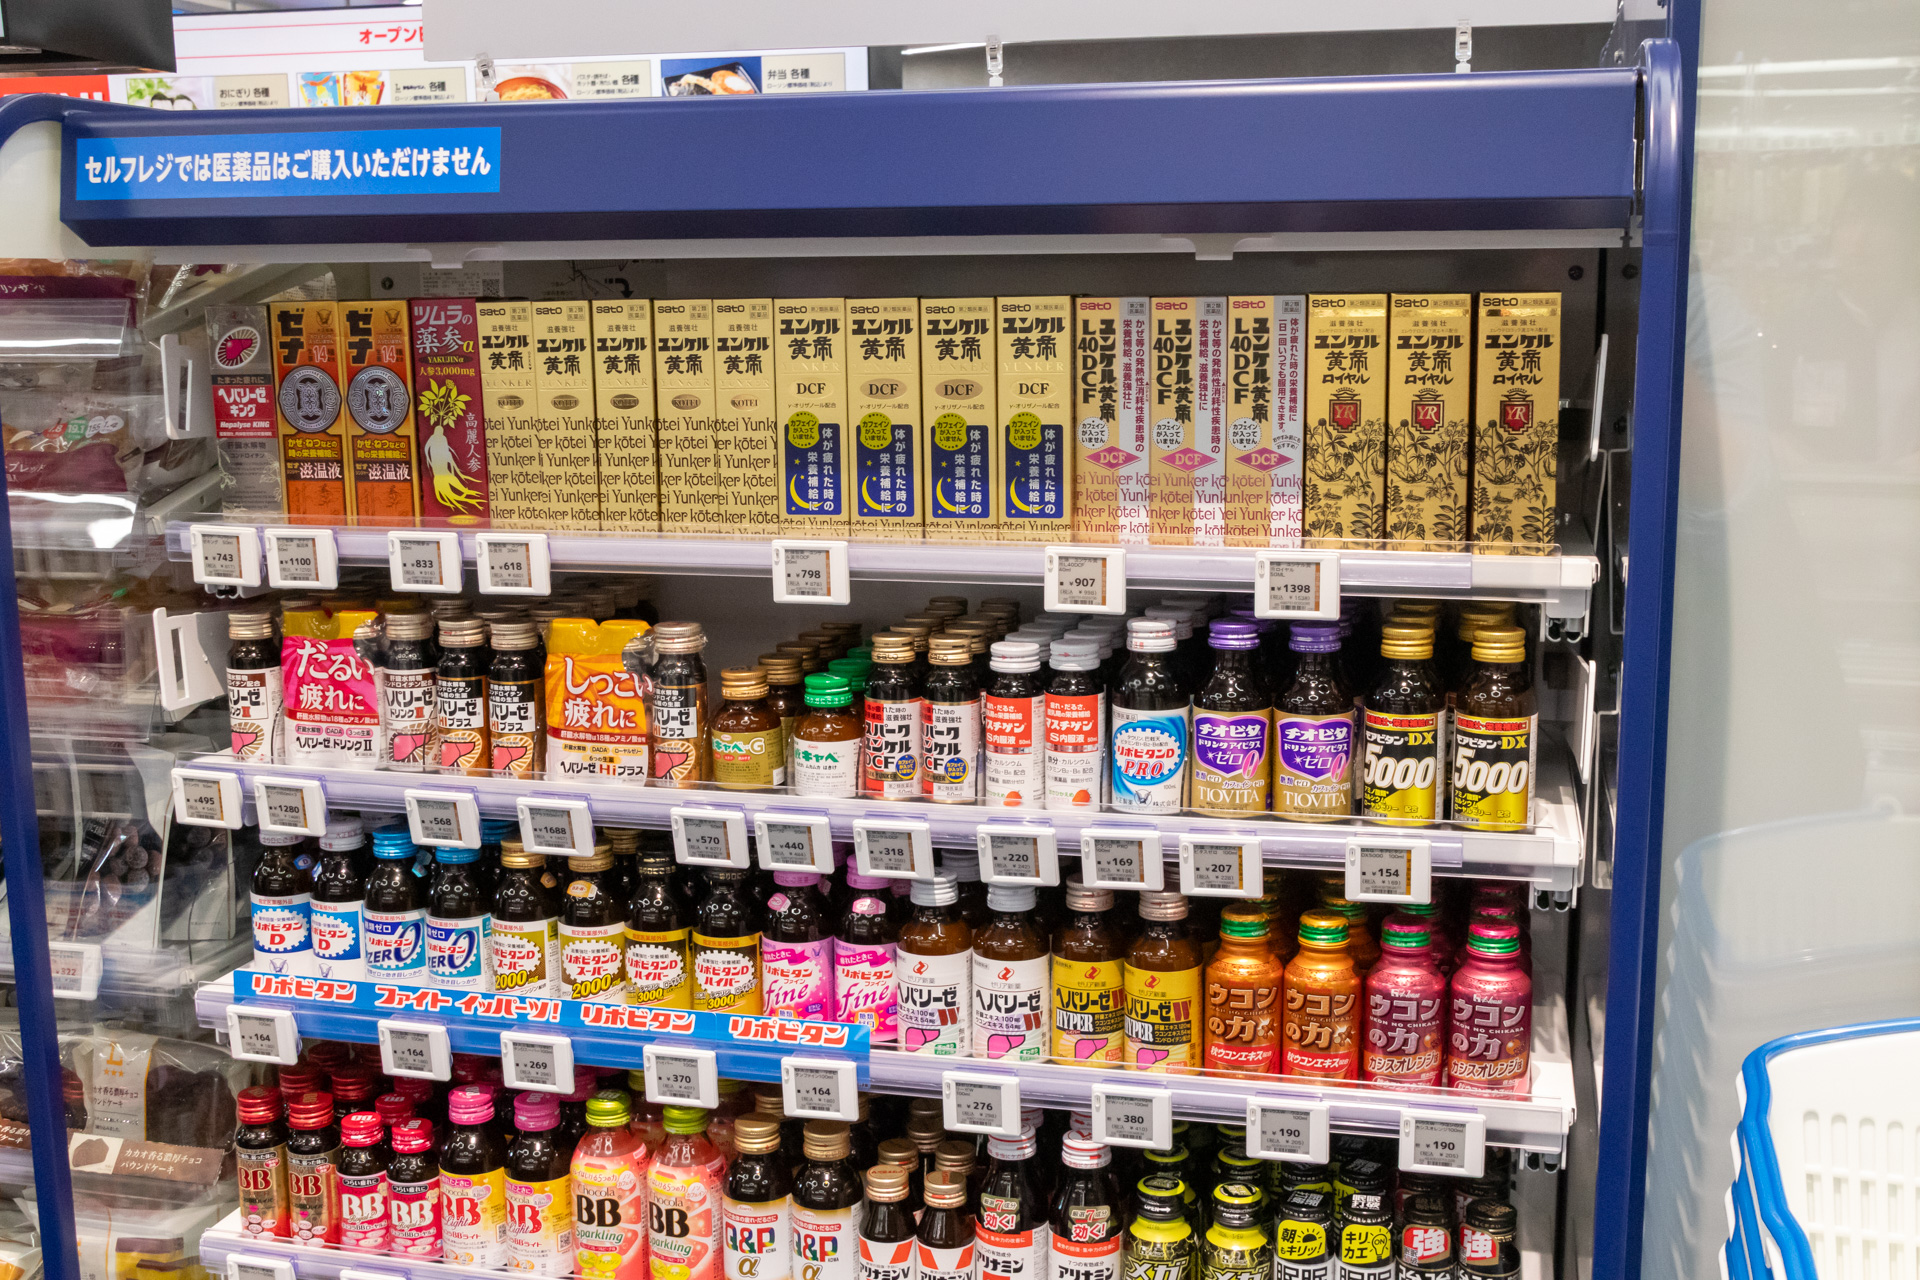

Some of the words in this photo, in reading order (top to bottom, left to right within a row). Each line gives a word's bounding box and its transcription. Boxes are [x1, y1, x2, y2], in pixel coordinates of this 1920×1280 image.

[621, 74, 639, 86] 各種
[767, 69, 787, 80] 弁当
[790, 68, 810, 80] 各種
[219, 87, 250, 99] おにぎり
[252, 86, 270, 97] 各種
[429, 81, 446, 92] 各種
[84, 146, 490, 184] セルフレジでは医薬品はご購入いただけません
[480, 307, 506, 316] sato
[1079, 302, 1111, 310] sato
[414, 305, 473, 326] ツムラの
[780, 319, 840, 335] ユンケル
[277, 308, 304, 364] ゼナ
[482, 335, 529, 348] ユンケル
[597, 337, 647, 351] ユンケル
[1314, 334, 1379, 349] ユンケル
[788, 337, 833, 361] 黄帝
[488, 351, 524, 371] 黄帝
[603, 354, 641, 376] 黄帝
[1325, 350, 1368, 372] 黄帝
[419, 366, 475, 376] 人参3,000mg
[1322, 374, 1370, 385] ロイヤル
[218, 388, 267, 403] ヘパリーゼ
[796, 382, 826, 394] DCF
[229, 404, 256, 417] キング
[1014, 420, 1040, 428] カフェイン
[465, 413, 481, 473] 高麗人参
[1014, 434, 1039, 442] いません
[300, 463, 342, 479] 滋温液
[368, 463, 410, 480] 滋温液
[822, 427, 834, 511] 体が疲れた時の
[808, 452, 819, 511] 栄養補給に
[296, 640, 374, 682] だるい
[300, 684, 364, 711] 疲れに
[564, 698, 635, 728] 疲れに
[1050, 732, 1085, 743] S内服液
[1199, 724, 1261, 737] チオビタ
[1408, 732, 1435, 745] DX
[1198, 739, 1228, 748] ドリンク
[1230, 739, 1261, 749] アイビタス
[1501, 735, 1527, 749] DX
[1117, 745, 1175, 759] リポビタンD
[560, 761, 596, 774] ヘパリーゼ
[1124, 760, 1164, 777] PRO
[1364, 743, 1436, 789] 5000
[1455, 747, 1528, 794] 5000
[1198, 786, 1259, 803] TIOVITA
[255, 922, 303, 932] リポビタン
[270, 934, 285, 945] D
[369, 938, 413, 947] リポビタン
[565, 953, 618, 964] リポビタンD
[627, 959, 678, 970] リポビタンD
[577, 966, 609, 976] スーパー
[635, 970, 668, 981] ハイパー
[842, 968, 893, 980] リポビタン
[572, 975, 612, 999] 2000
[864, 979, 886, 987] ファイン
[838, 984, 890, 1017] fine
[976, 992, 1041, 1014] ヘパリーゼ
[1056, 987, 1111, 1011] ヘパリーゼ
[1209, 984, 1277, 1009] ウコン
[252, 975, 357, 1002] リポビタン
[376, 986, 451, 1010] ファイト
[456, 994, 561, 1022] イッパーツ!
[581, 1002, 695, 1033] リポビタン
[729, 1015, 849, 1047] リポビタン
[1370, 994, 1440, 1021] ウコン
[1454, 999, 1525, 1027] ウコン
[1056, 1009, 1094, 1032] HYPER
[1209, 1016, 1256, 1041] の力
[1369, 1028, 1419, 1054] の力
[1453, 1033, 1501, 1060] の力
[239, 1167, 271, 1190] BB
[290, 1173, 323, 1196] BB
[578, 1187, 616, 1197] Chocola
[342, 1193, 385, 1219] BB
[391, 1200, 434, 1226] BB
[577, 1194, 621, 1227] BB
[985, 1213, 1016, 1230] 効く!
[575, 1227, 624, 1243] Sparkling
[725, 1221, 775, 1254] Q&P
[1072, 1223, 1105, 1241] 効く!
[1281, 1228, 1295, 1243] 朝
[1345, 1231, 1370, 1245] キリ
[1412, 1229, 1447, 1258] 強
[1462, 1231, 1495, 1258] 強
[1344, 1246, 1368, 1259] カエ
